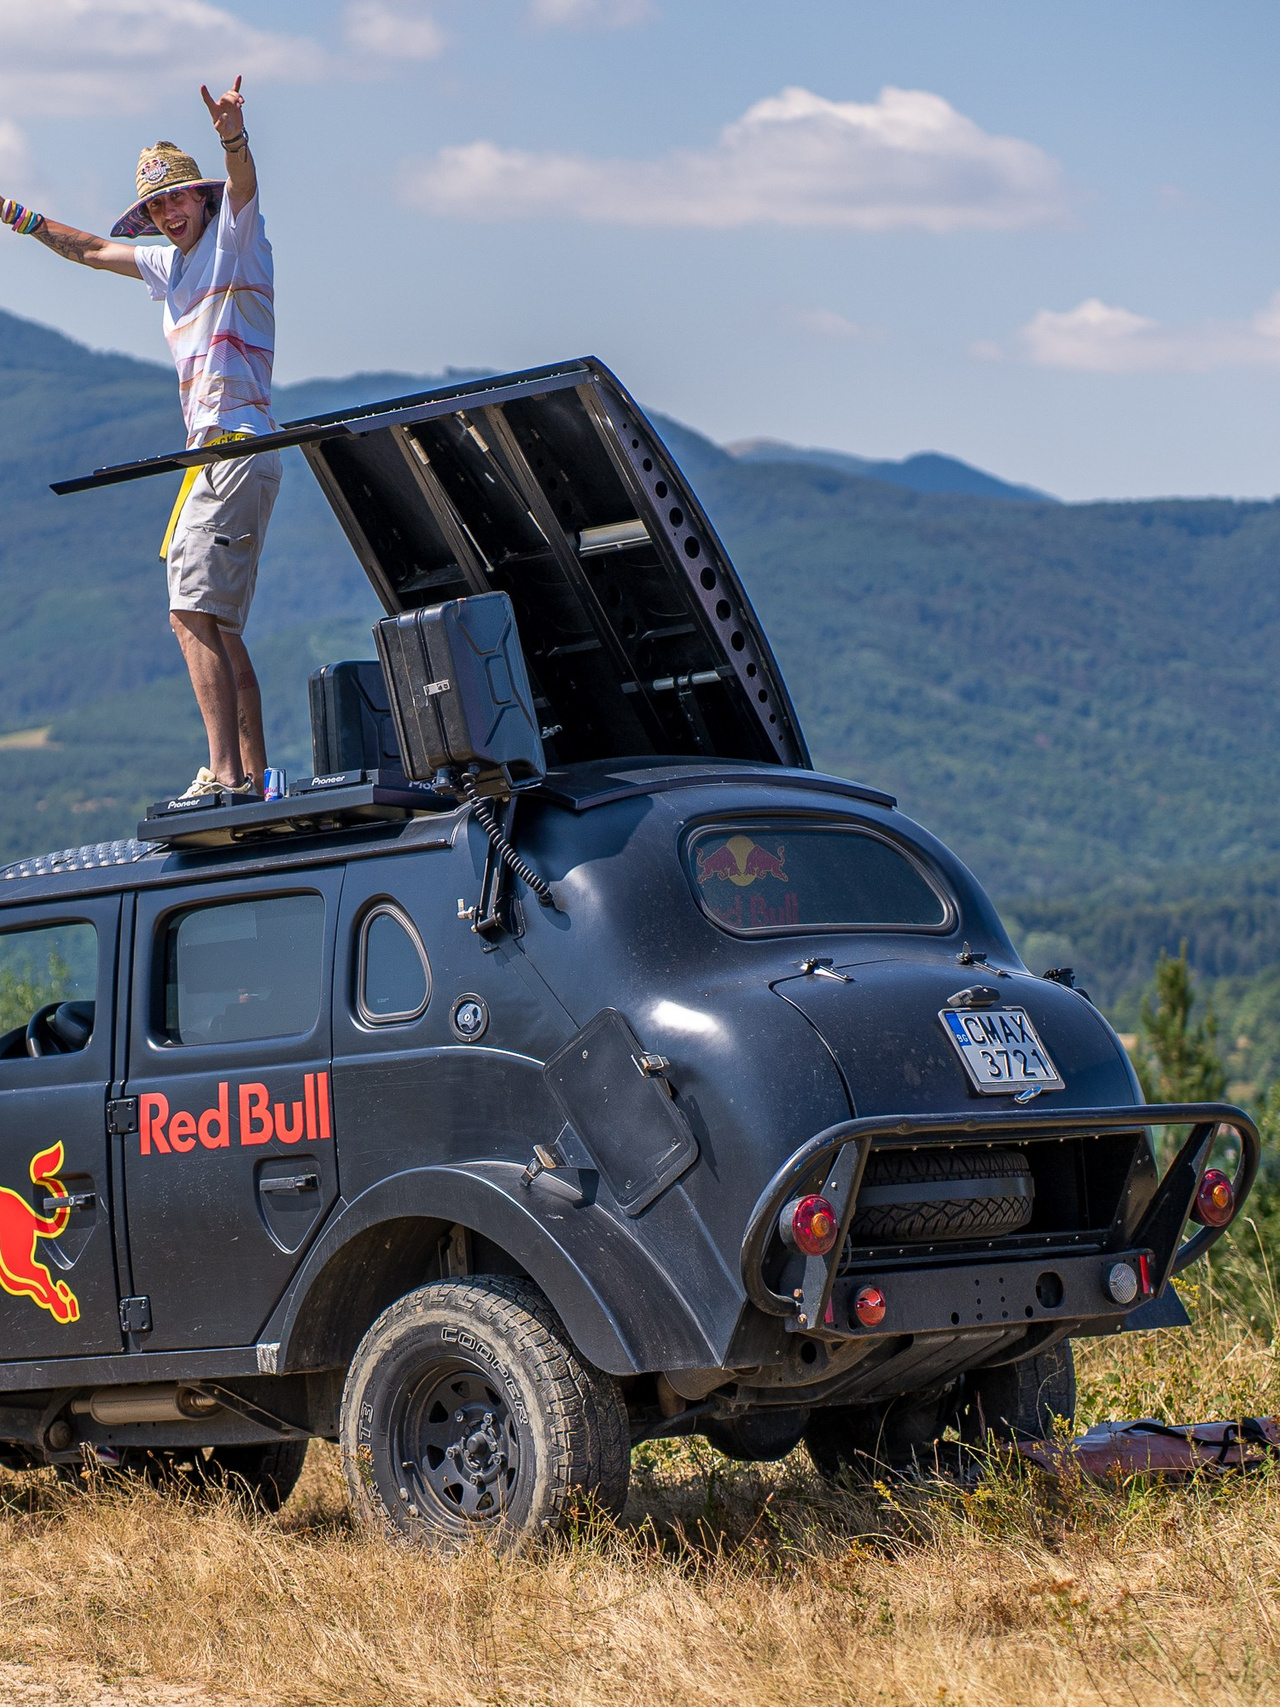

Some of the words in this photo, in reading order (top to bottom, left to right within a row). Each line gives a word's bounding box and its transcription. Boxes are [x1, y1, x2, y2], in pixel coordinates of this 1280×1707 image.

[311, 775, 345, 786] Pioneer
[167, 798, 200, 809] Pioneer
[749, 893, 799, 927] Bull
[955, 1034, 969, 1043] BG
[962, 1015, 1034, 1046] CMAX
[980, 1048, 1049, 1078] 3721
[140, 1081, 230, 1155] Red
[238, 1071, 332, 1146] Bull
[440, 1326, 530, 1426] COOPER
